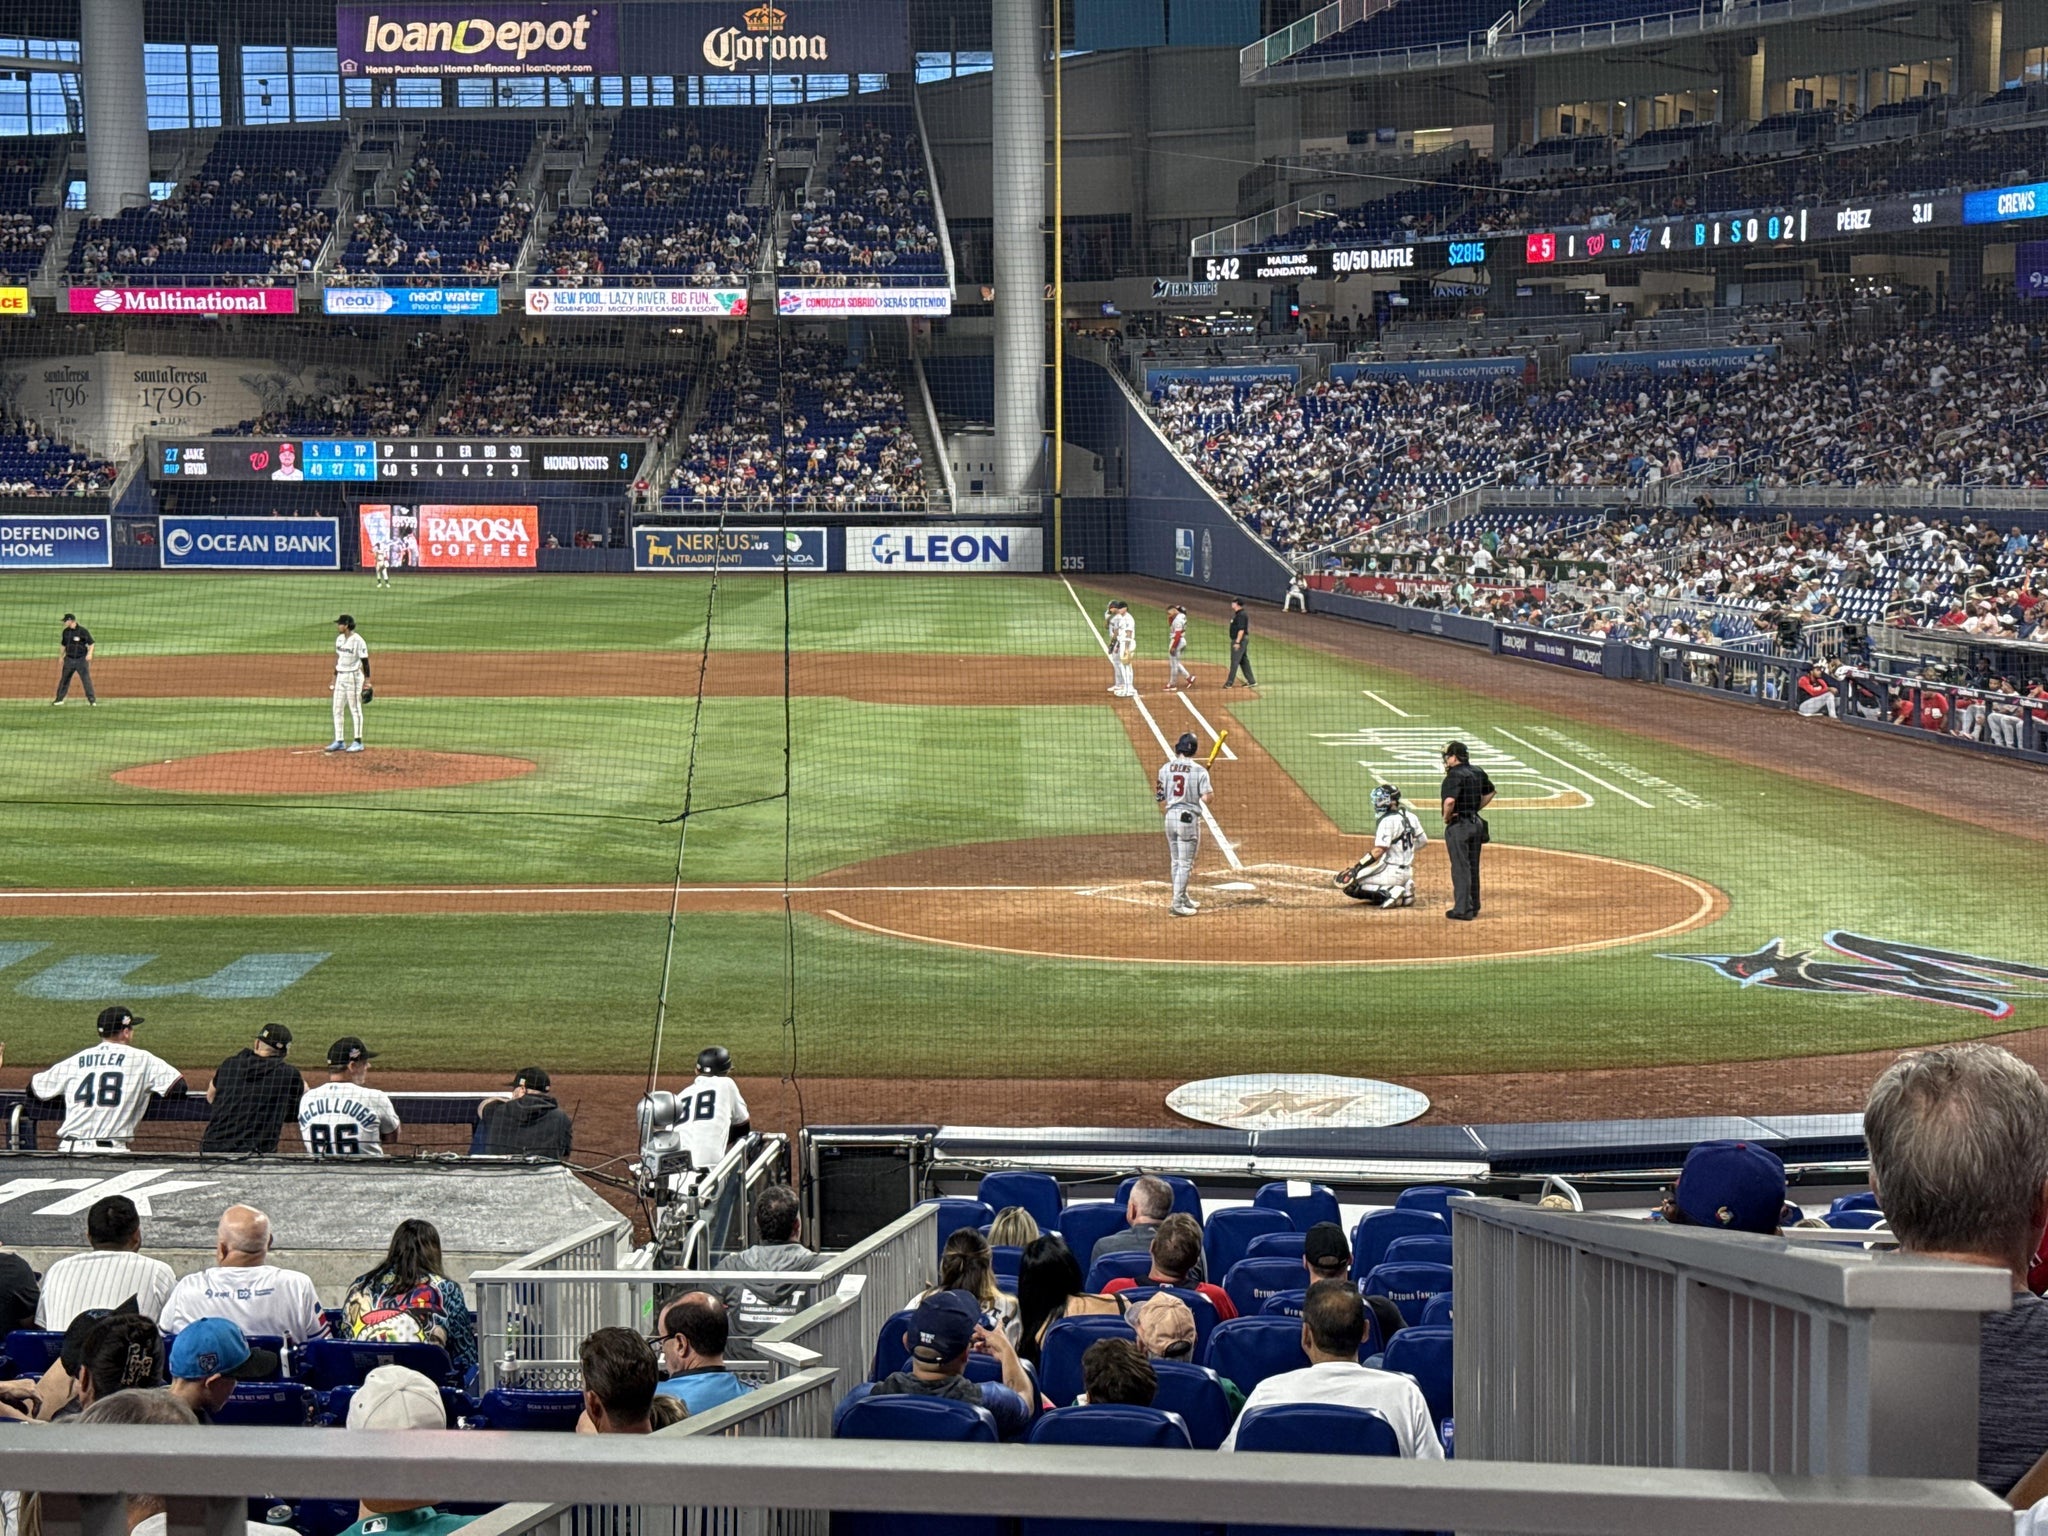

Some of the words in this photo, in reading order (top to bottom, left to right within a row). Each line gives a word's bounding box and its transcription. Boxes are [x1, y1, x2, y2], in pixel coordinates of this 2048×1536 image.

[365, 14, 590, 60] loanDepot
[703, 26, 828, 71] Corona
[366, 65, 393, 74] Home
[395, 65, 439, 74] Purchase
[444, 65, 472, 74] Home
[474, 64, 521, 74] Refinance
[526, 64, 592, 74] loanDepot.com
[1997, 191, 2036, 214] CREWS
[1837, 208, 1872, 231] PÉREZ
[1541, 238, 1551, 258] 5
[1660, 226, 1671, 249] 4
[1695, 223, 1705, 246] B
[1731, 220, 1742, 242] S
[1783, 215, 1794, 239] 2
[1267, 254, 1308, 266] MARLINS
[1332, 251, 1369, 272] 50/50
[1371, 248, 1414, 268] RAFFLE
[1206, 258, 1240, 281] 5:42
[1257, 265, 1317, 278] FOUNDATION
[445, 291, 485, 302] water
[554, 291, 577, 304] NEW
[609, 291, 634, 304] LAZY
[671, 291, 687, 304] BIG
[1170, 282, 1191, 296] TEAM
[1192, 282, 1219, 296] STORE
[125, 291, 267, 311] Multinational
[806, 297, 845, 308] CONDUZCA
[847, 297, 875, 308] SOBRIO
[909, 297, 947, 308] DETENIDO
[165, 448, 179, 461] 27
[183, 448, 205, 460] JAKE
[312, 445, 319, 456] S
[354, 445, 366, 456] TP
[410, 446, 418, 457] H
[459, 446, 472, 457] ER
[332, 464, 344, 475] 27
[382, 464, 397, 476] 4.0
[410, 464, 418, 476] 5
[436, 464, 443, 476] 4
[462, 464, 469, 476] 4
[486, 464, 493, 476] 2
[511, 464, 518, 476] 3
[543, 456, 578, 470] MOUND
[579, 456, 609, 470] VISITS
[620, 453, 628, 470] 3
[1, 526, 99, 540] DEFENDING
[427, 518, 530, 542] RAPOSA
[1, 543, 54, 557] HOME
[197, 534, 269, 552] OCEAN
[274, 535, 333, 553] BANK
[431, 544, 528, 556] COFFEE
[905, 535, 1009, 563] LEON
[1062, 556, 1084, 570] 335
[1172, 775, 1186, 797] 3
[78, 1053, 126, 1069] BUTLER
[74, 1071, 124, 1108] 48
[310, 1123, 360, 1155] 86
[741, 1289, 806, 1306] BT
